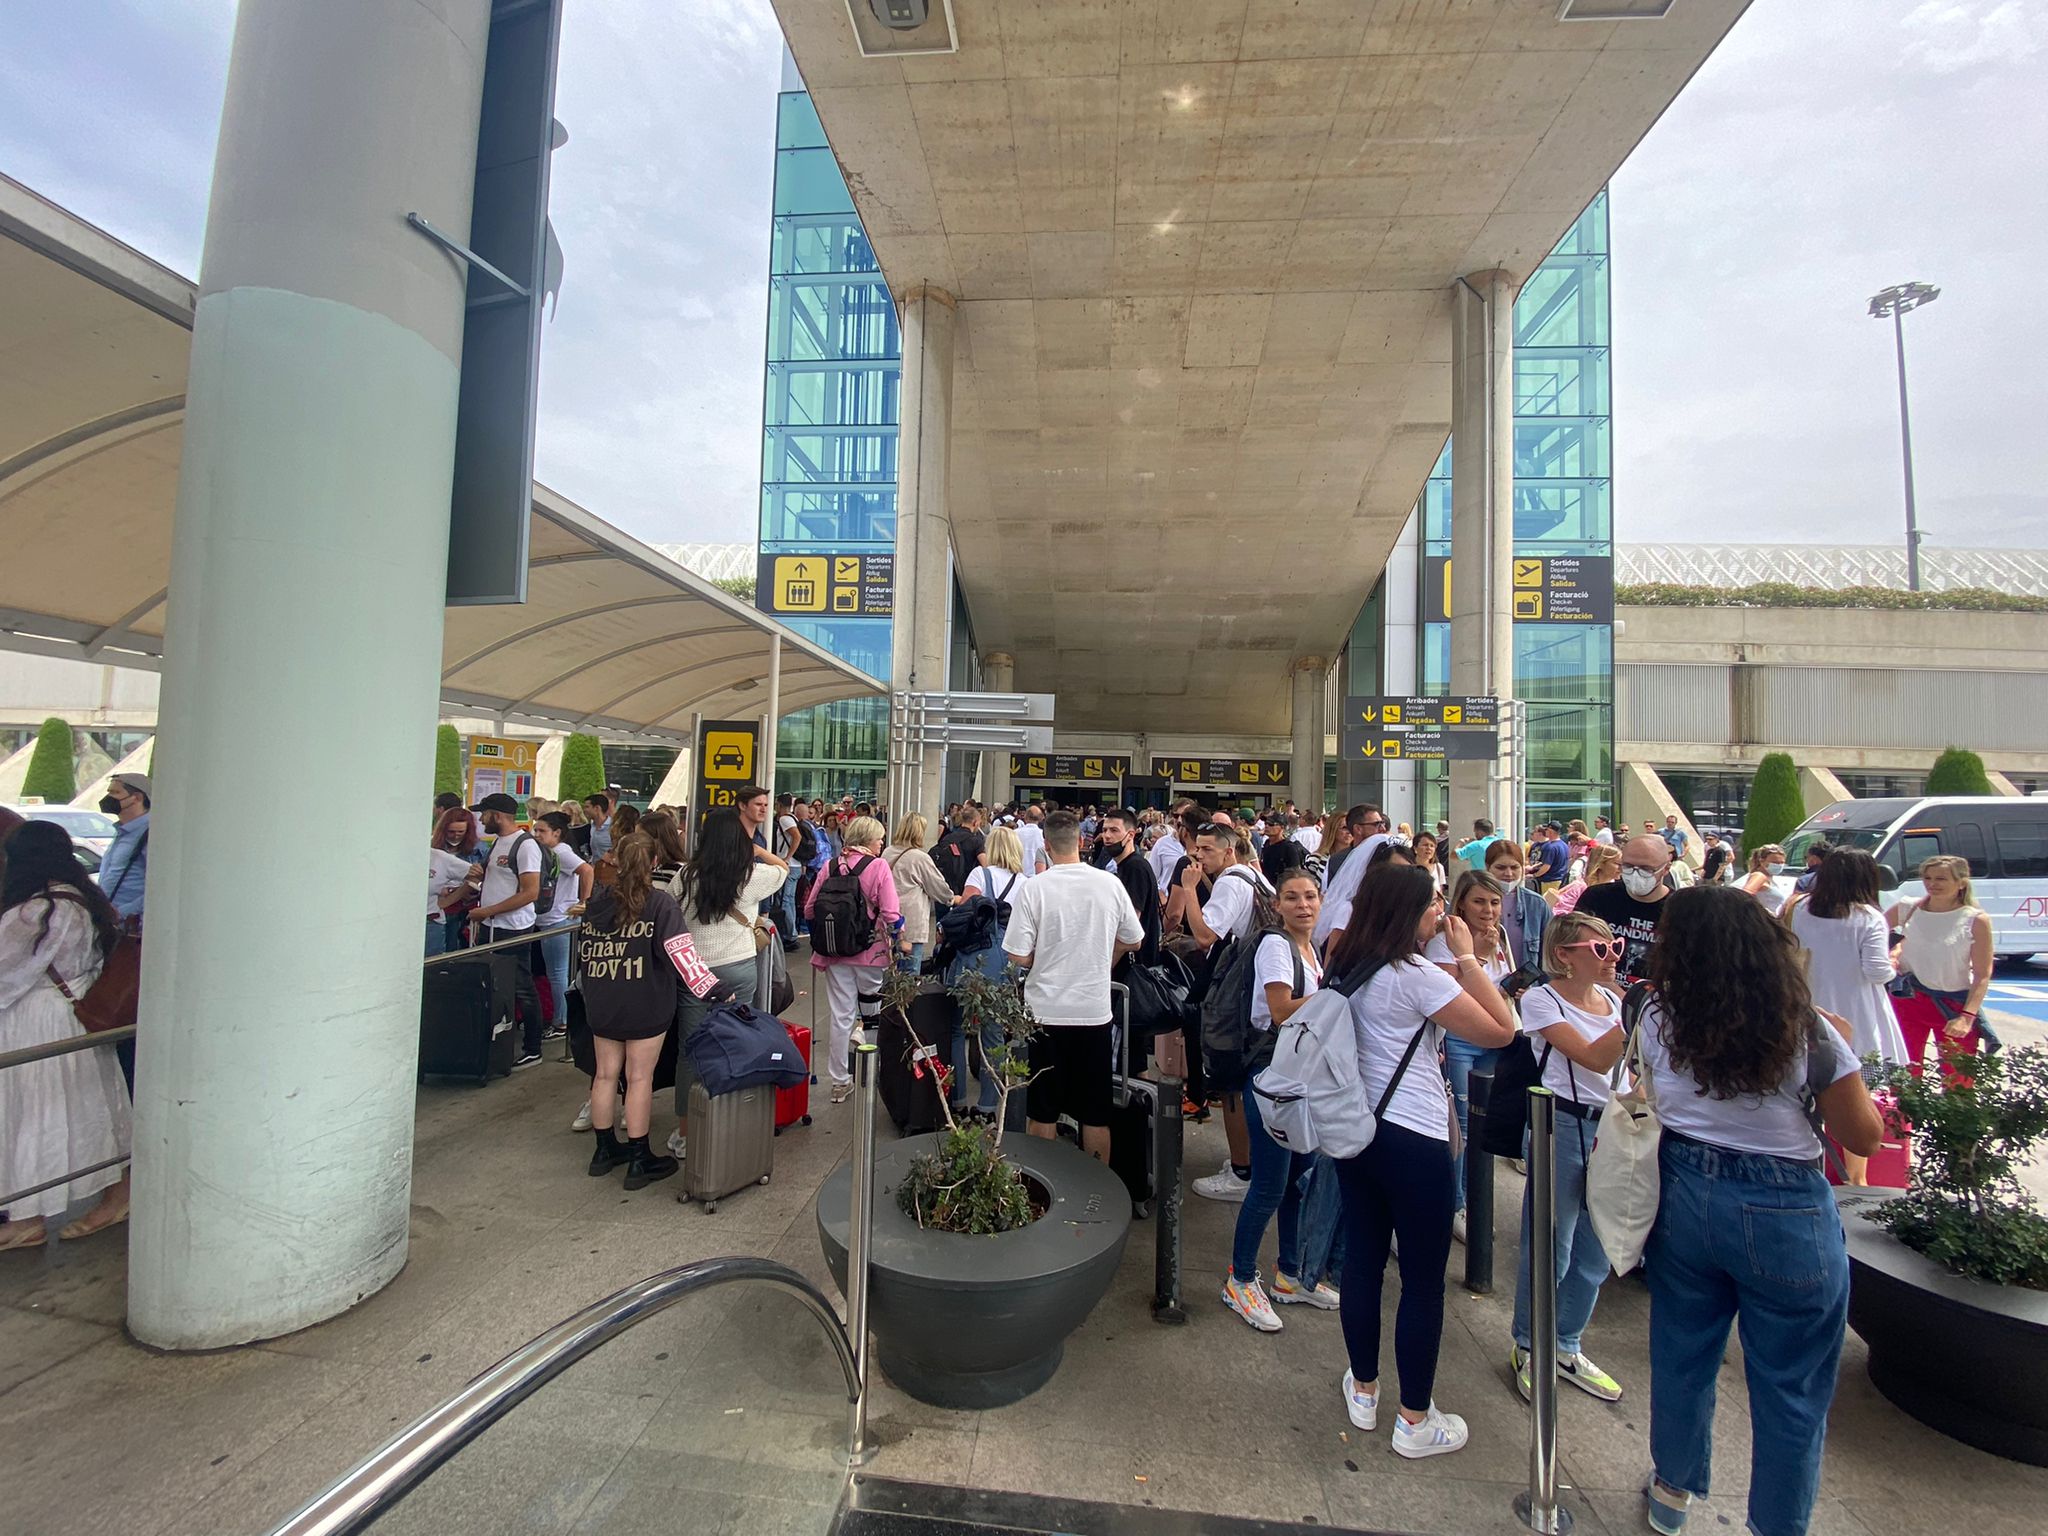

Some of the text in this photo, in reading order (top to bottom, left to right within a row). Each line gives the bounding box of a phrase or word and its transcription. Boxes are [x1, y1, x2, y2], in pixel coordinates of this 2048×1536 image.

[1550, 612, 1593, 620] Facturación
[704, 784, 737, 806] Tax
[1629, 917, 1655, 931] THE
[622, 956, 644, 980] 11
